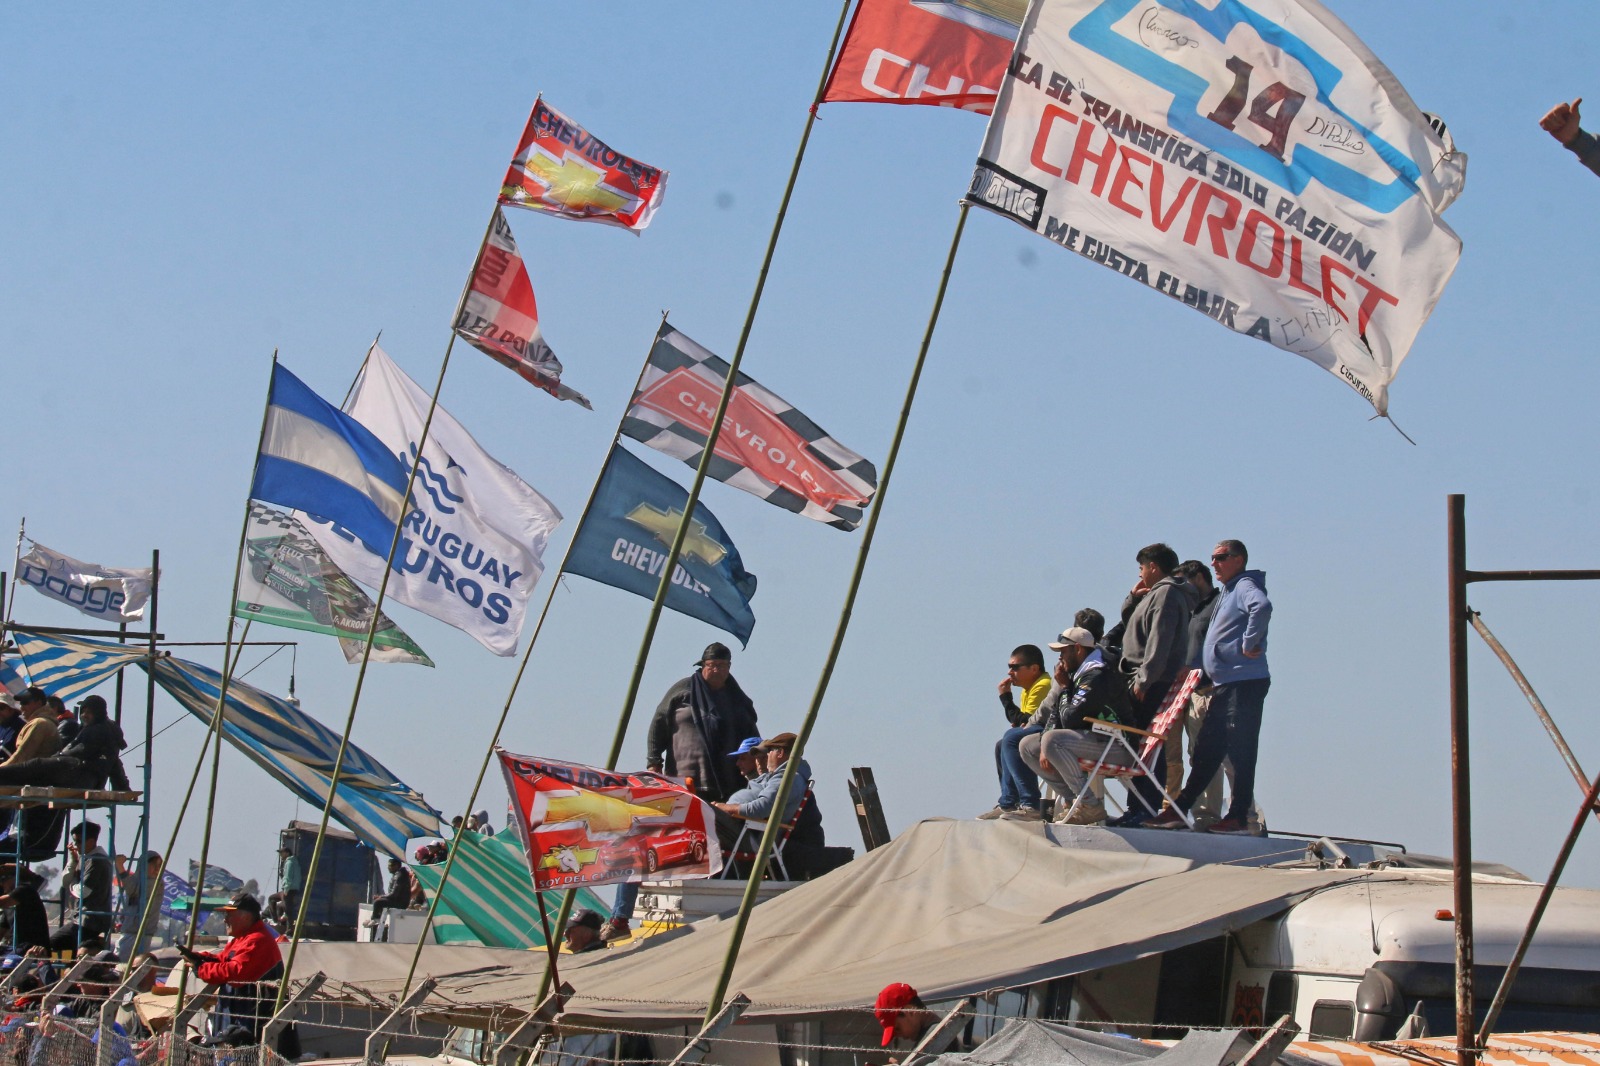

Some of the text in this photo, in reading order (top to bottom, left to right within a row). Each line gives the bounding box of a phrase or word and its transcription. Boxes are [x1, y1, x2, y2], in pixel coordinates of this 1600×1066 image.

[534, 105, 657, 183] CHEVROLET
[1207, 55, 1306, 163] 14
[1031, 104, 1399, 337] CHEVROLET
[1212, 160, 1268, 209] SOLO
[1044, 215, 1080, 249] ME
[1080, 235, 1150, 286] GUSTA
[1246, 316, 1271, 343] A
[678, 391, 825, 495] CHEVROLET
[22, 564, 126, 614] Dodge
[400, 509, 522, 590] RUGUAY
[339, 616, 367, 630] AKRON
[539, 867, 636, 889] SOY DEL CHIVO
